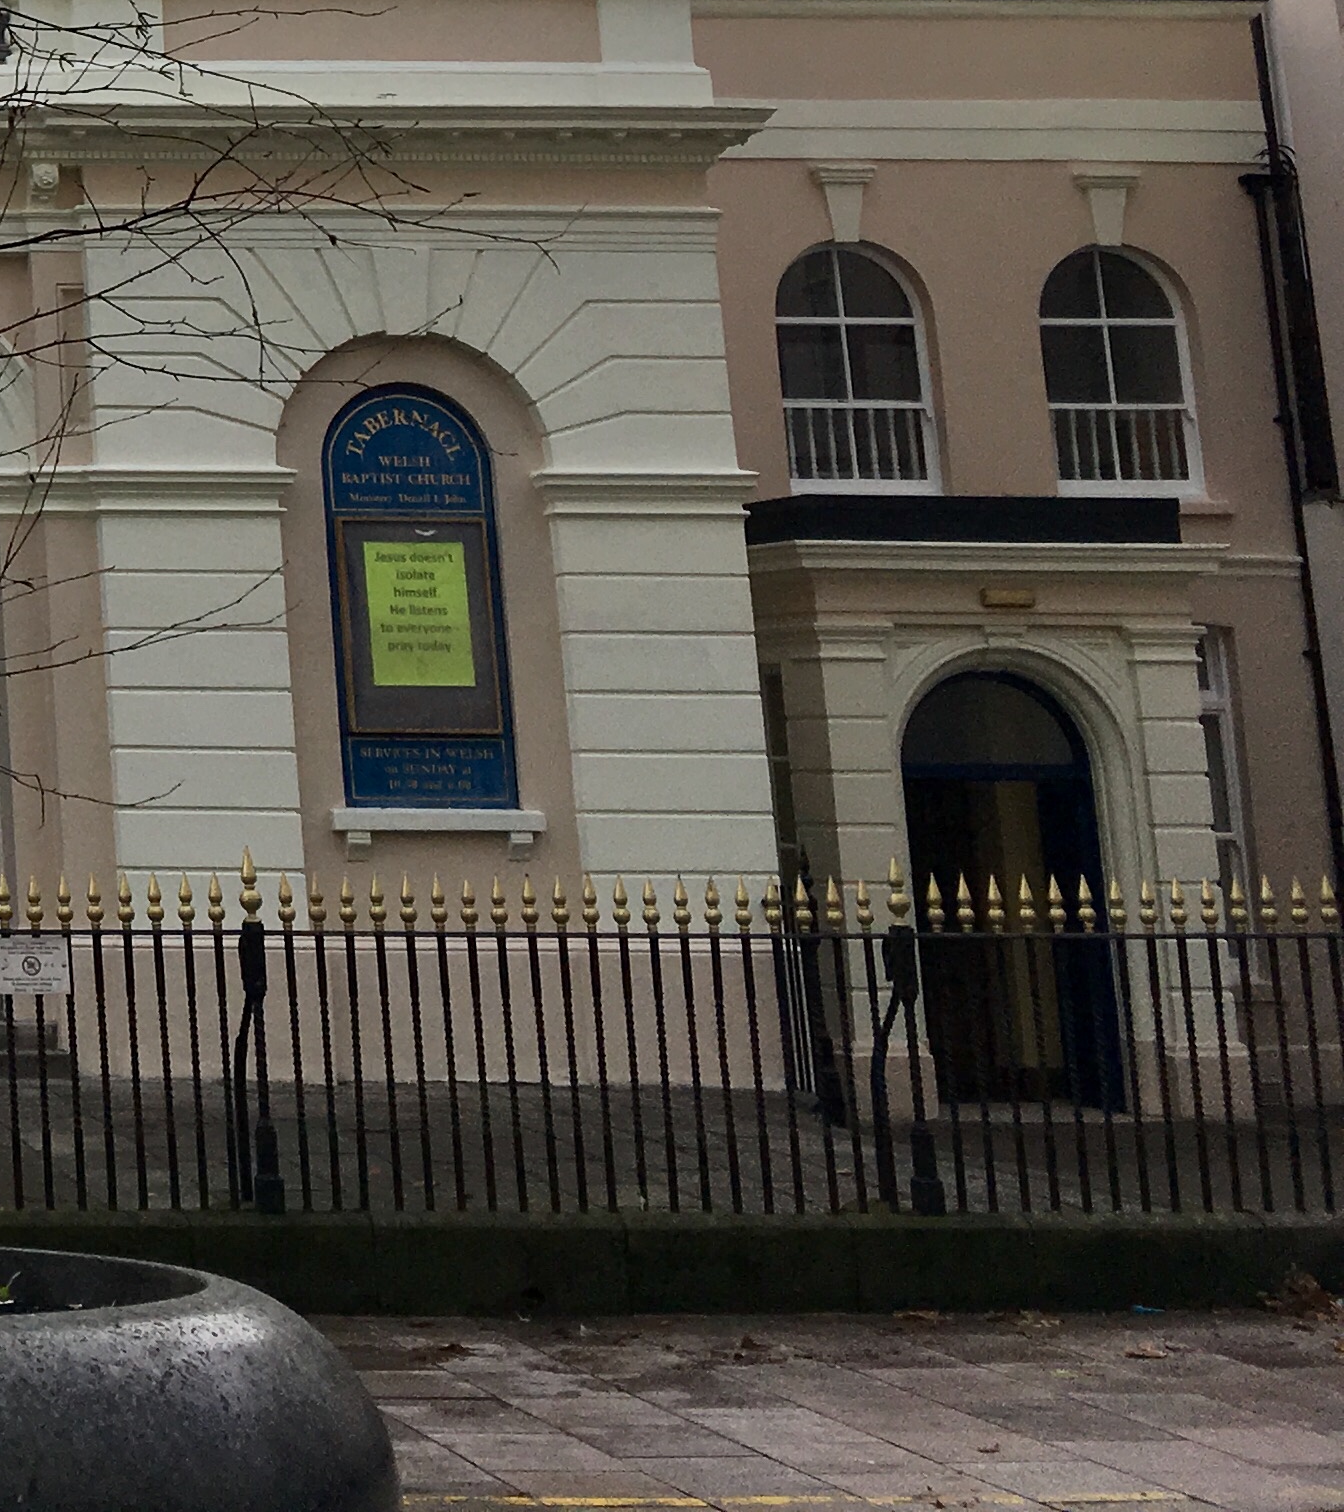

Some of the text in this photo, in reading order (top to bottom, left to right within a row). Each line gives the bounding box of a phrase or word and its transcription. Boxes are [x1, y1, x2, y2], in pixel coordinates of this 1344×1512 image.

[346, 407, 461, 461] TABERNACL
[378, 455, 431, 468] WELSH
[341, 472, 471, 486] BAPTIST CHURCH
[374, 551, 454, 564] Jesus doesn't
[396, 569, 435, 581] isolate
[390, 604, 448, 616] He listens
[380, 622, 394, 633] to
[387, 641, 414, 653] pray
